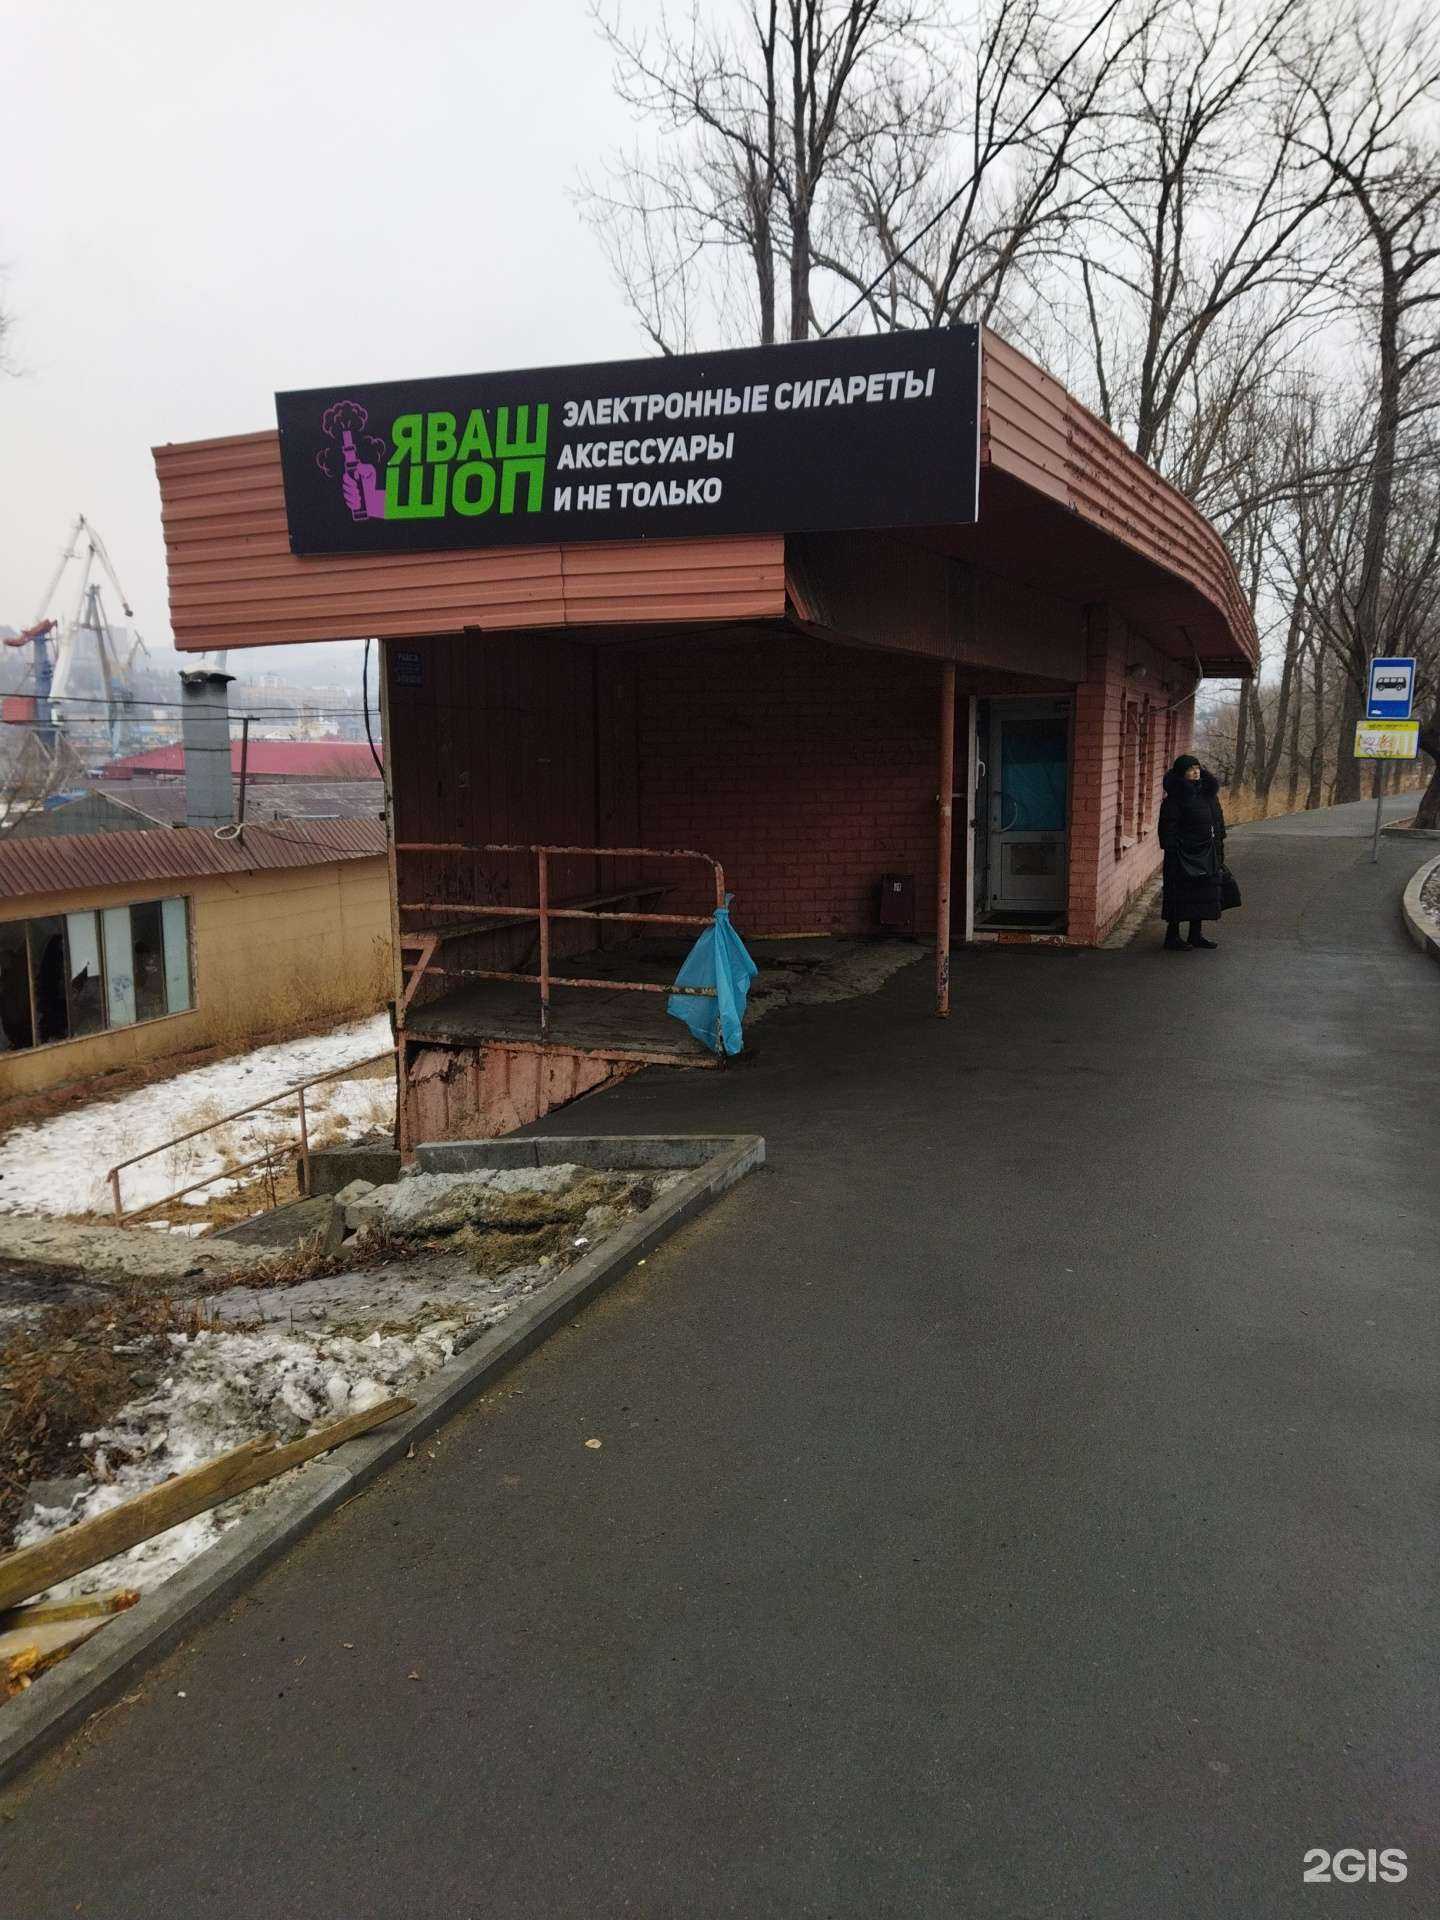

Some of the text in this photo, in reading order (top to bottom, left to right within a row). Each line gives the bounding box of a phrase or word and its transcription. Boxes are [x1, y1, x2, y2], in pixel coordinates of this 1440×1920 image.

[562, 368, 936, 427] ЭЛЕКТРОННЫЕ СИГАРЕТЫ
[388, 403, 550, 466] ЯВАШ
[556, 432, 735, 470] АКСЕССУАРЫ
[384, 456, 547, 519] ШОП
[553, 477, 723, 512] И НЕ ТОЛЬКО
